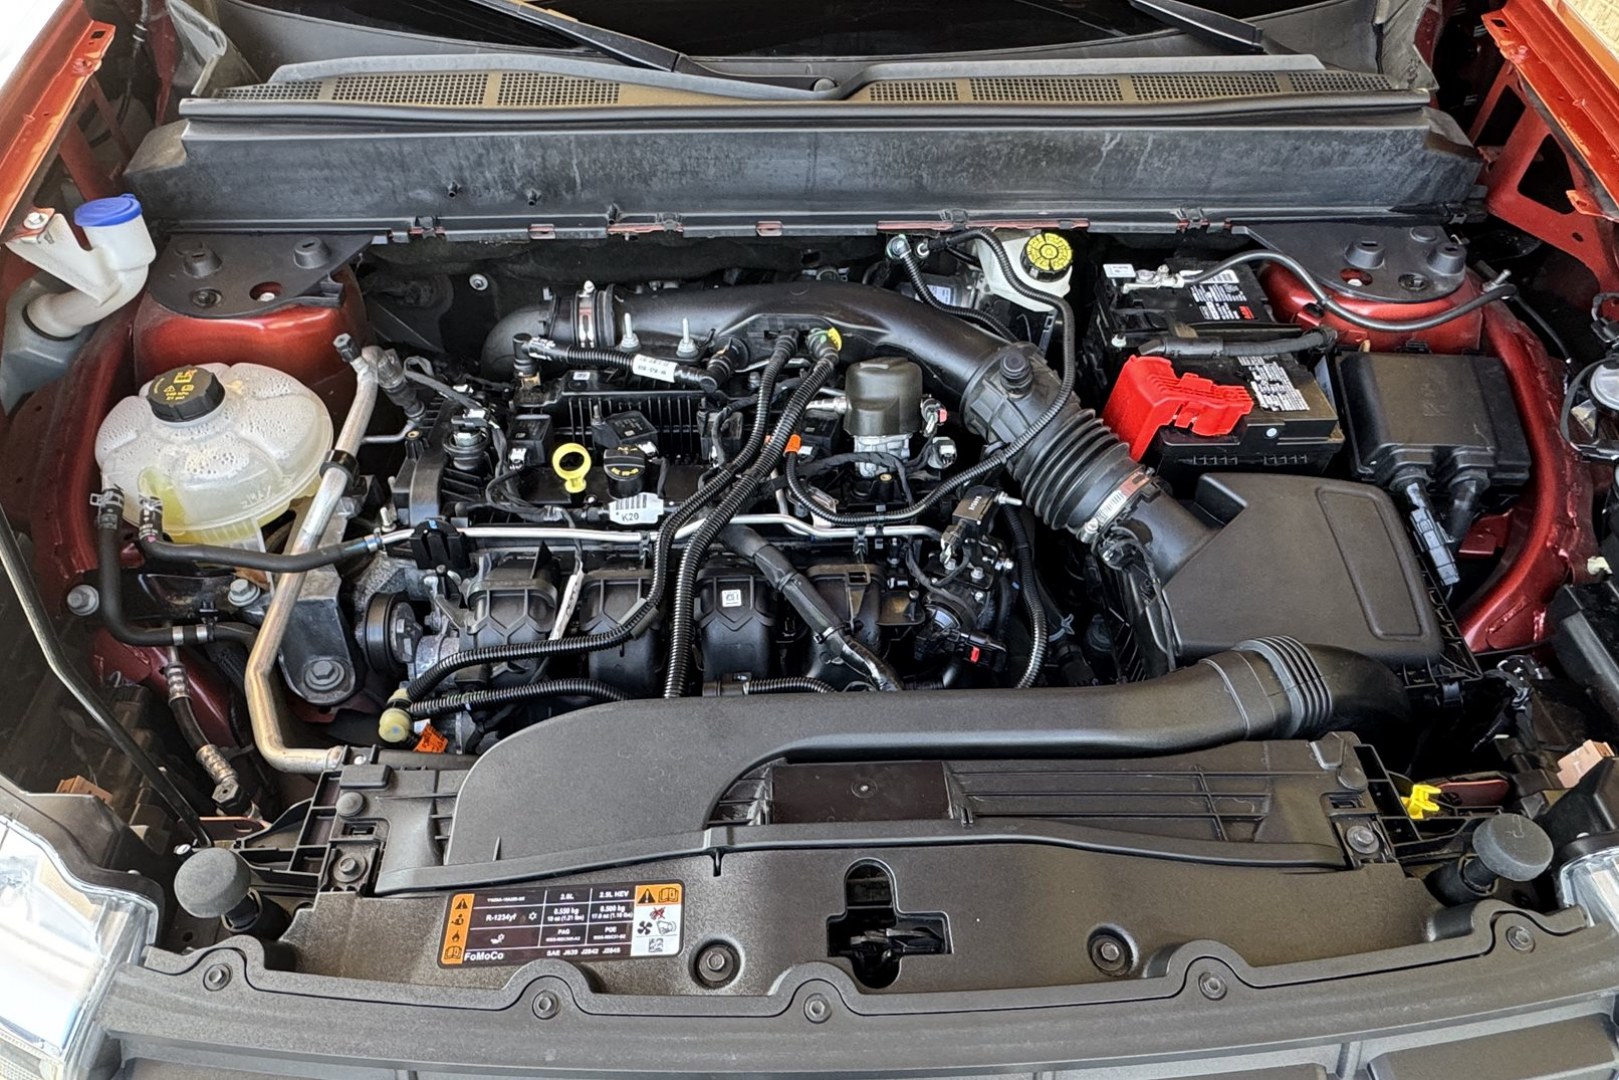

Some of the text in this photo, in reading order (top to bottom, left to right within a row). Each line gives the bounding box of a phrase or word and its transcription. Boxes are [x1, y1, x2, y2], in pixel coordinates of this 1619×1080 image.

[571, 907, 579, 915] kg
[485, 913, 517, 922] R-1234yf
[464, 951, 504, 962] FoMoCo
